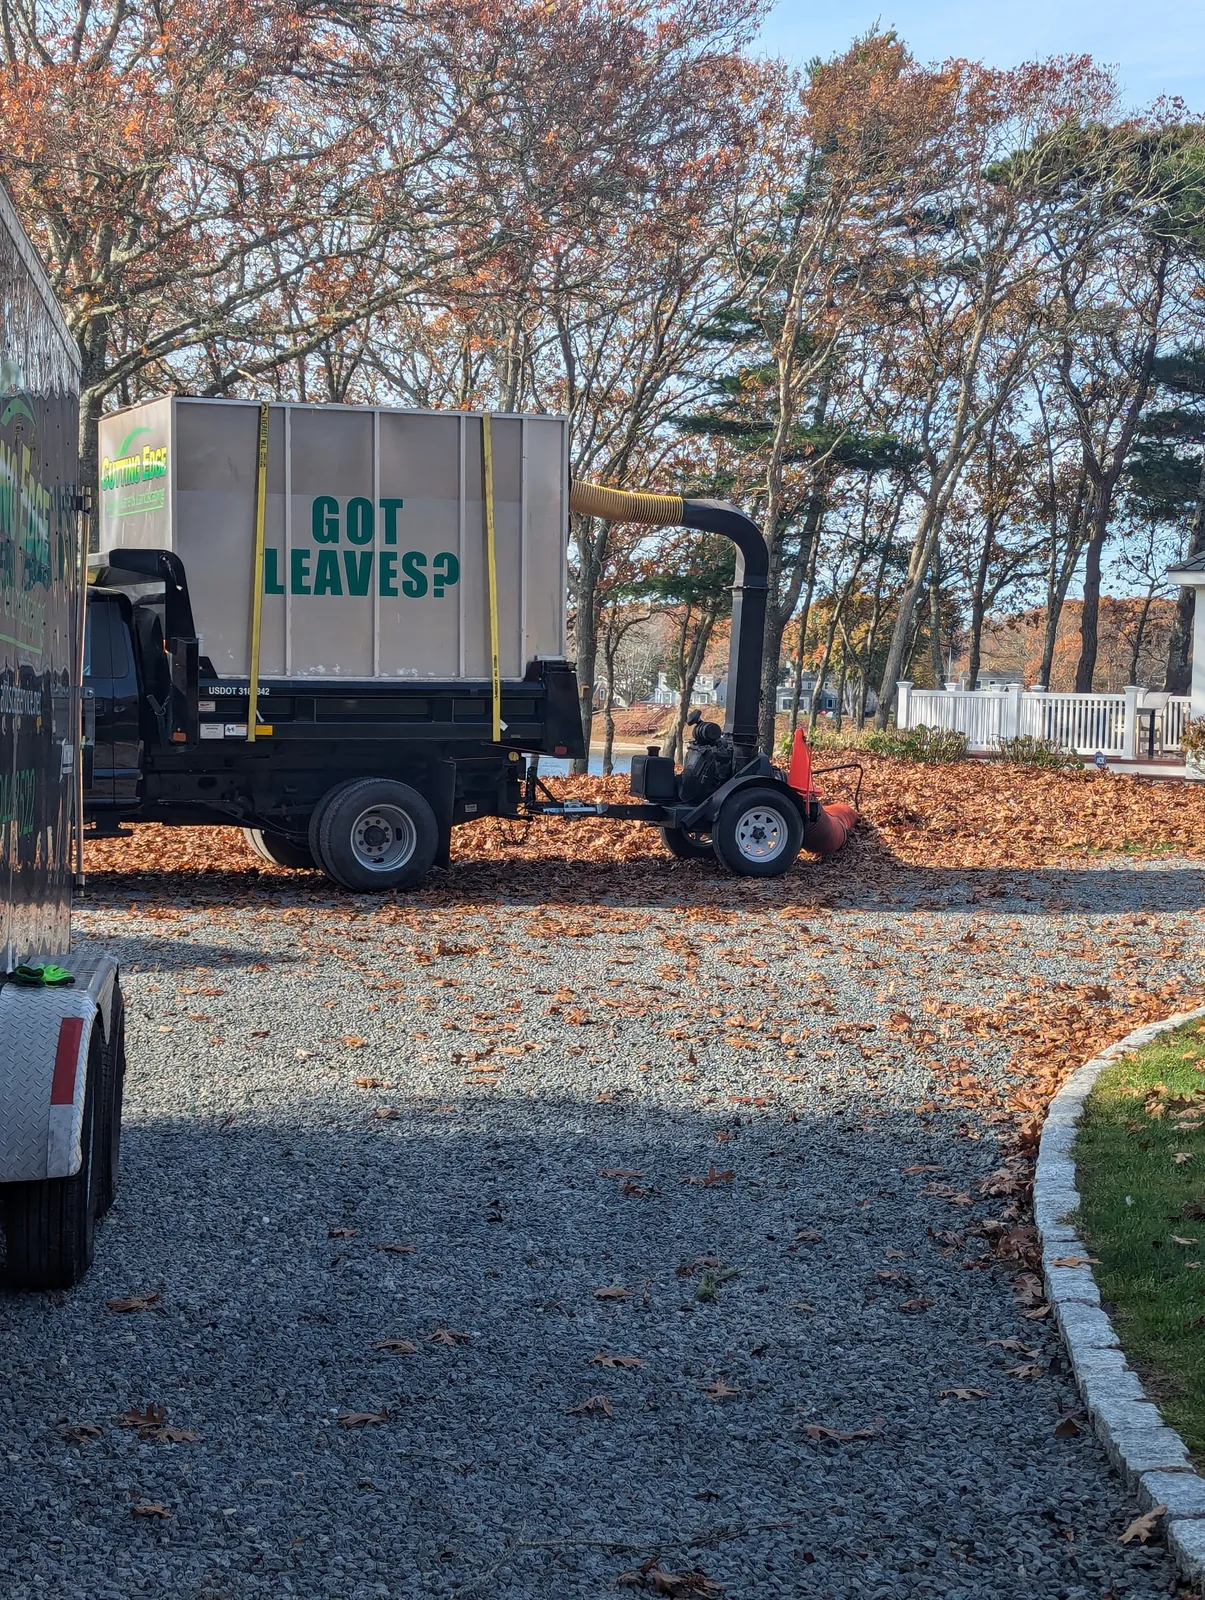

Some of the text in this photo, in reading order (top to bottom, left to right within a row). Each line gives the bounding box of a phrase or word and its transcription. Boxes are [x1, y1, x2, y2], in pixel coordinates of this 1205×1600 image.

[101, 444, 167, 491] CUTTING EDGE
[312, 495, 404, 546] GOT
[264, 548, 460, 598] LEAVES?
[208, 686, 238, 695] USDOT
